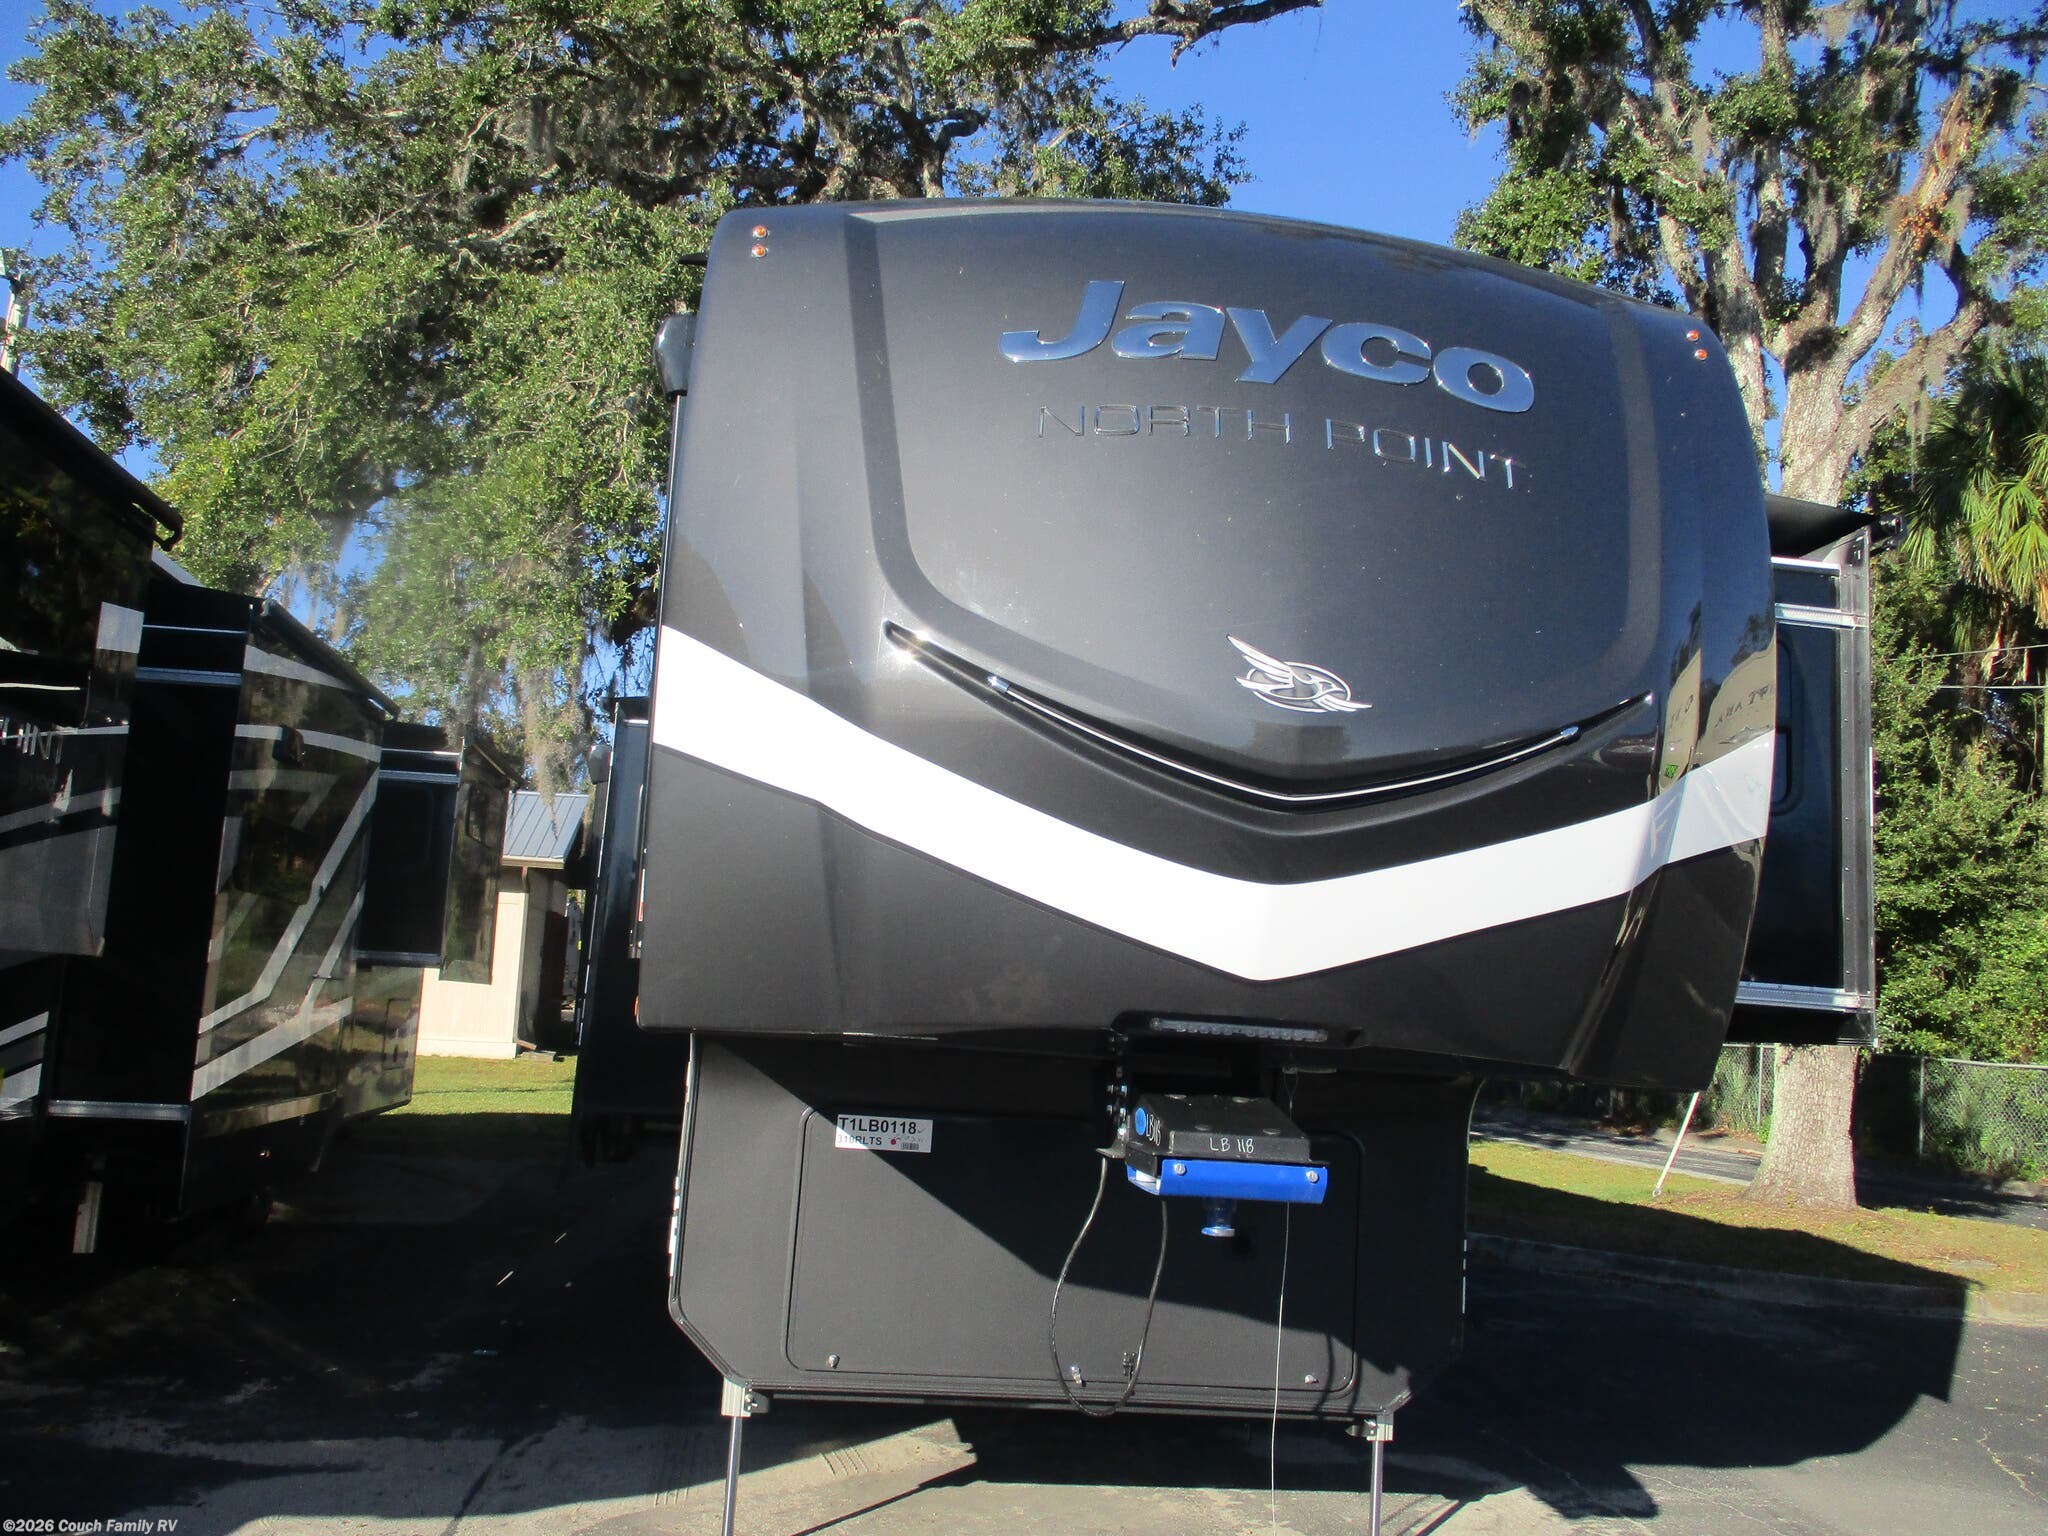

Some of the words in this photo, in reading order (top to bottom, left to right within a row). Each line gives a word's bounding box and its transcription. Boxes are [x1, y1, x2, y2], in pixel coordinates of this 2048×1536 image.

[1000, 279, 1534, 413] Jayco
[1038, 405, 1291, 444] NORTH
[1326, 418, 1527, 489] POINT
[838, 1117, 917, 1135] T1LB0118
[837, 1134, 882, 1146] 310RLTS
[1209, 1137, 1230, 1152] LB
[1237, 1138, 1255, 1154] 118
